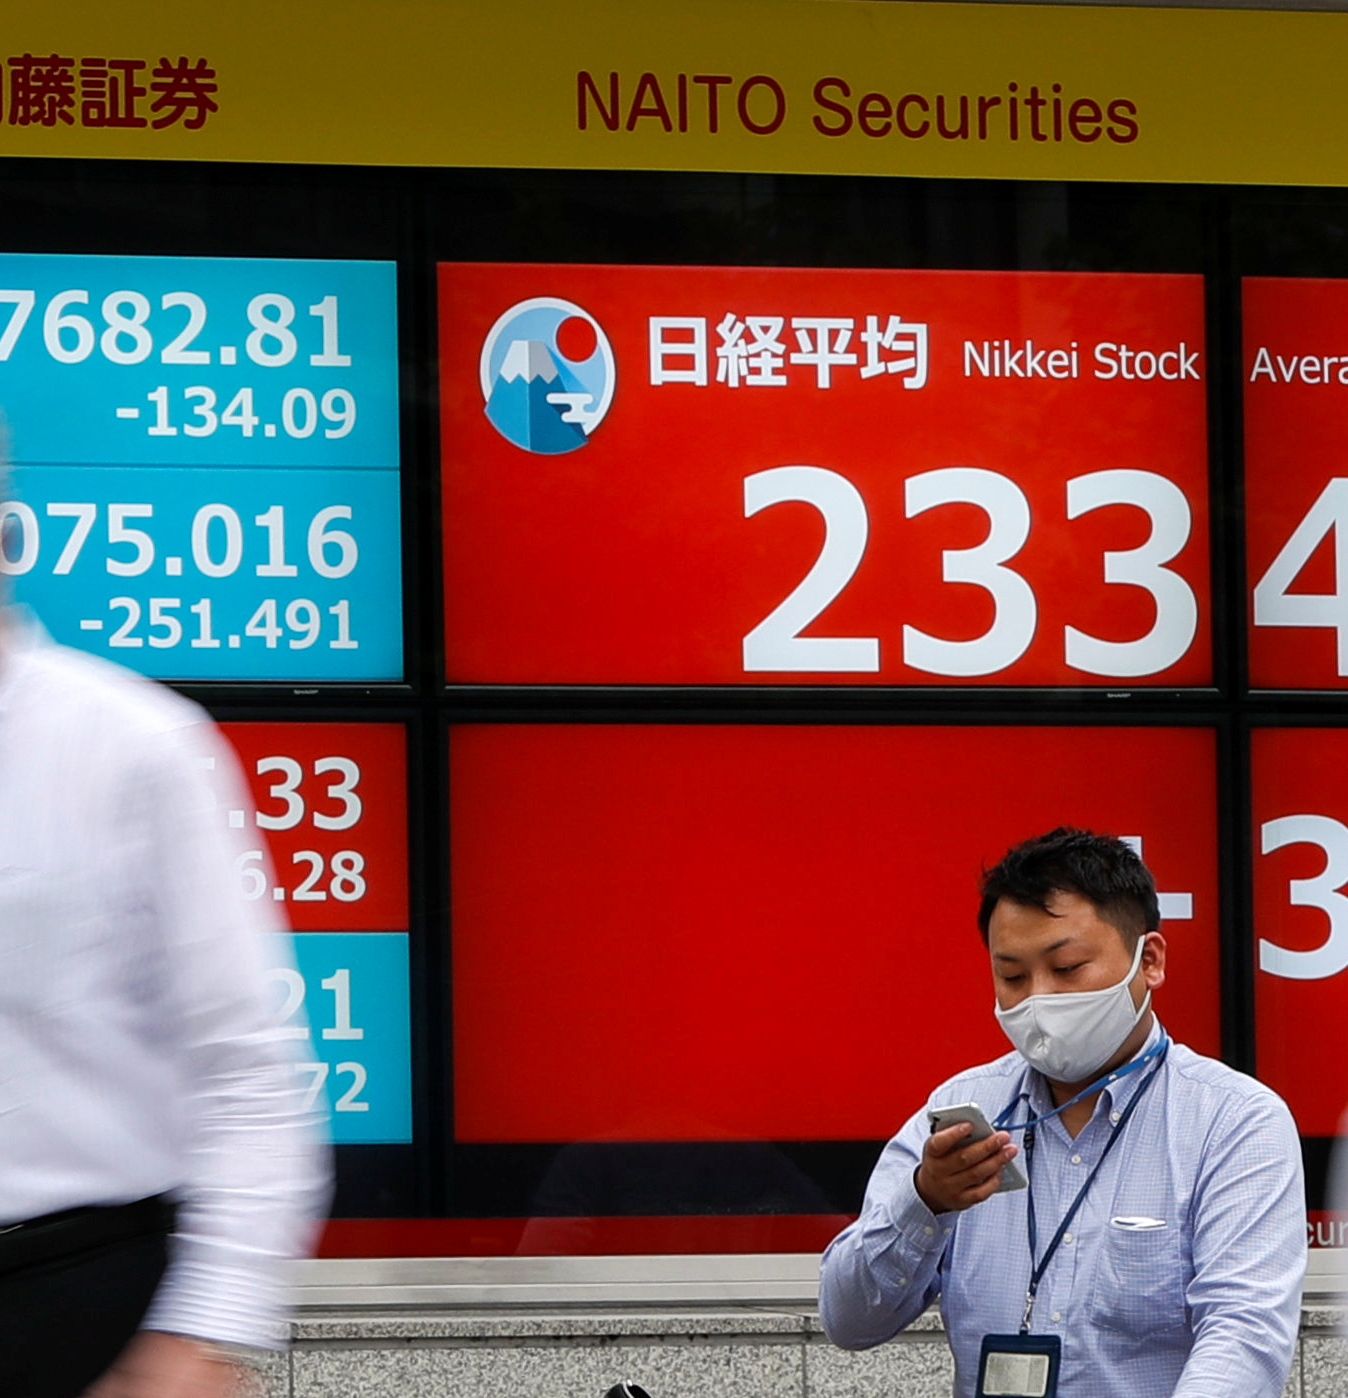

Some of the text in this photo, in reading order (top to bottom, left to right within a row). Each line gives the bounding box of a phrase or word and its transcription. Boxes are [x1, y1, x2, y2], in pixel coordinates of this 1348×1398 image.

[577, 70, 1140, 144] NAITO Securities
[649, 312, 928, 389] 日経平均
[964, 340, 1078, 379] Nikkei
[1094, 342, 1200, 381] Stock
[116, 386, 357, 439] -134.09
[80, 598, 360, 650] -251.491
